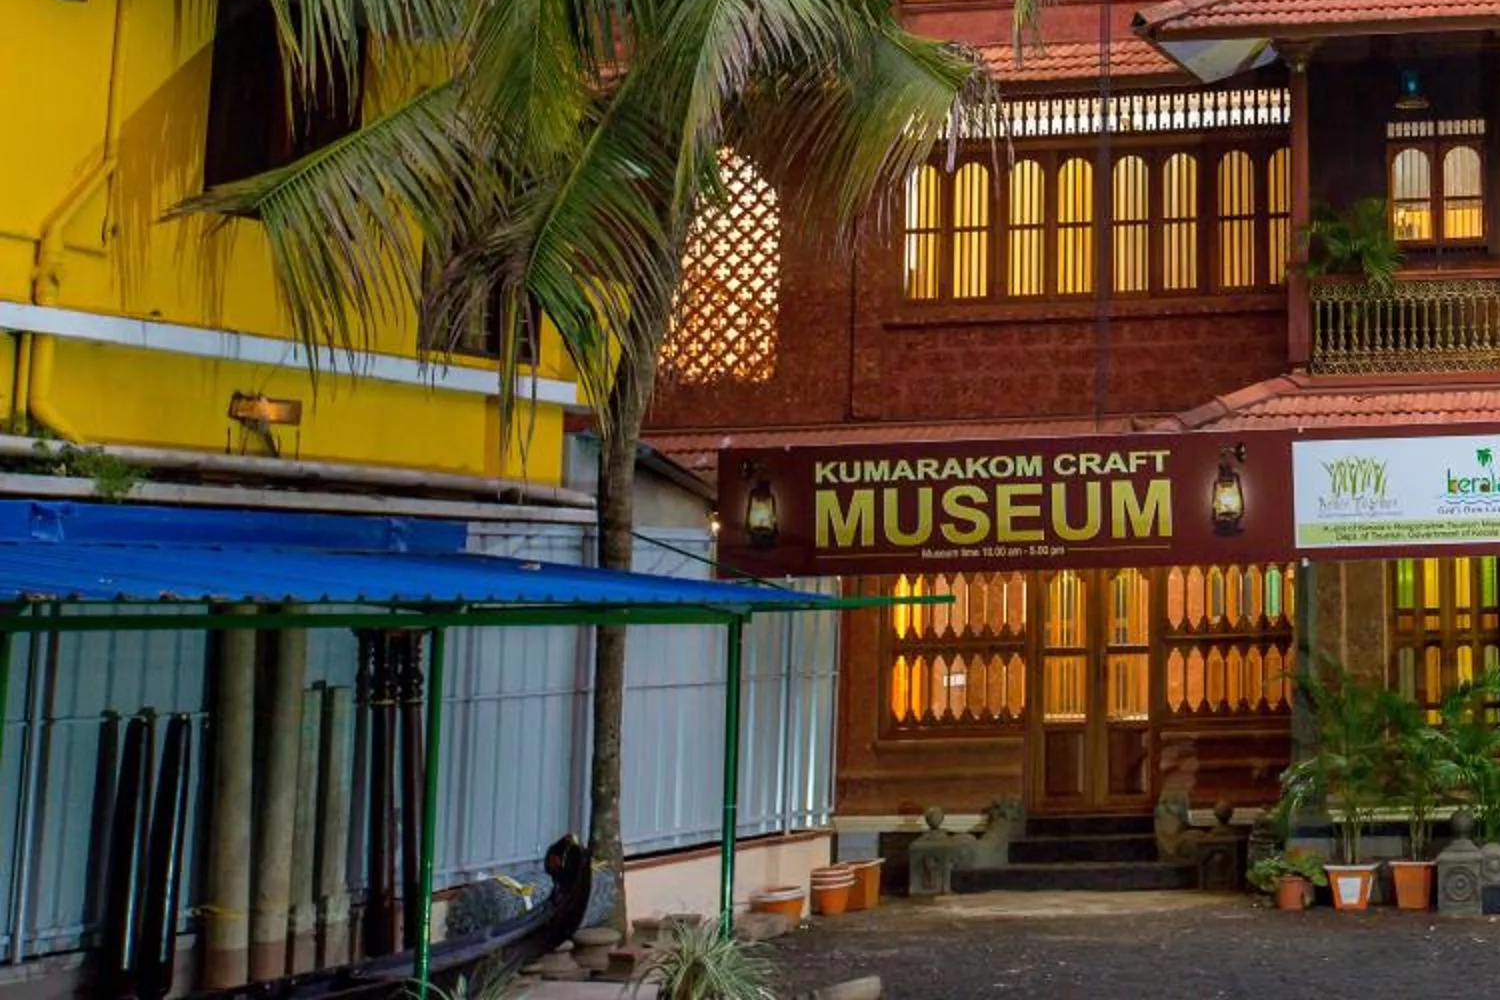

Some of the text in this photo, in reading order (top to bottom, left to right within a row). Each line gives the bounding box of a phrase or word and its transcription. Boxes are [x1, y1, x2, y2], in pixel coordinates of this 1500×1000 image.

[815, 450, 1171, 484] KUMARAKOM CRAFT
[815, 479, 1173, 548] MUSEUM
